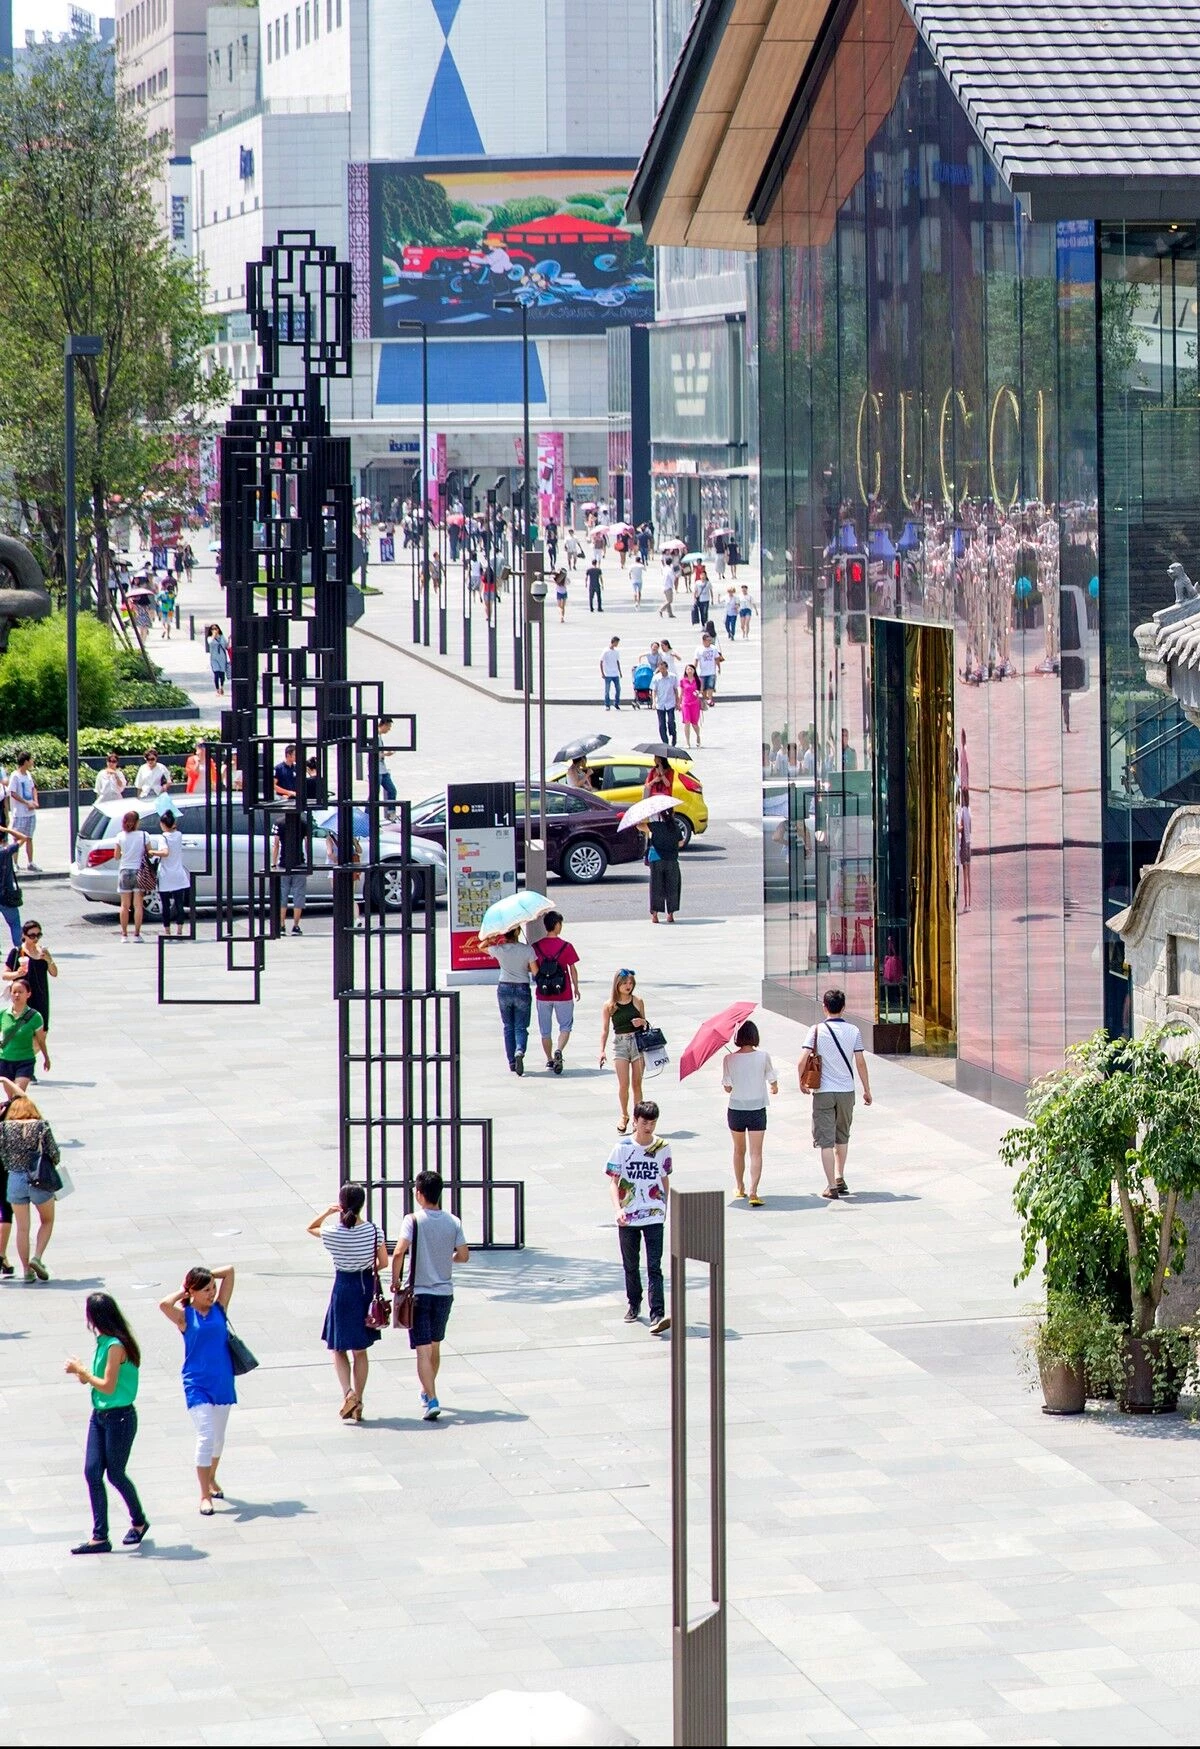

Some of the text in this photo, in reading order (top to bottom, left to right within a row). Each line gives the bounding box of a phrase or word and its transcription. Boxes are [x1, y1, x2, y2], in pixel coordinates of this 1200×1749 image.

[856, 385, 1044, 515] GUCCI
[494, 812, 510, 826] L1
[625, 1161, 659, 1171] STAR
[627, 1170, 659, 1180] WARS
